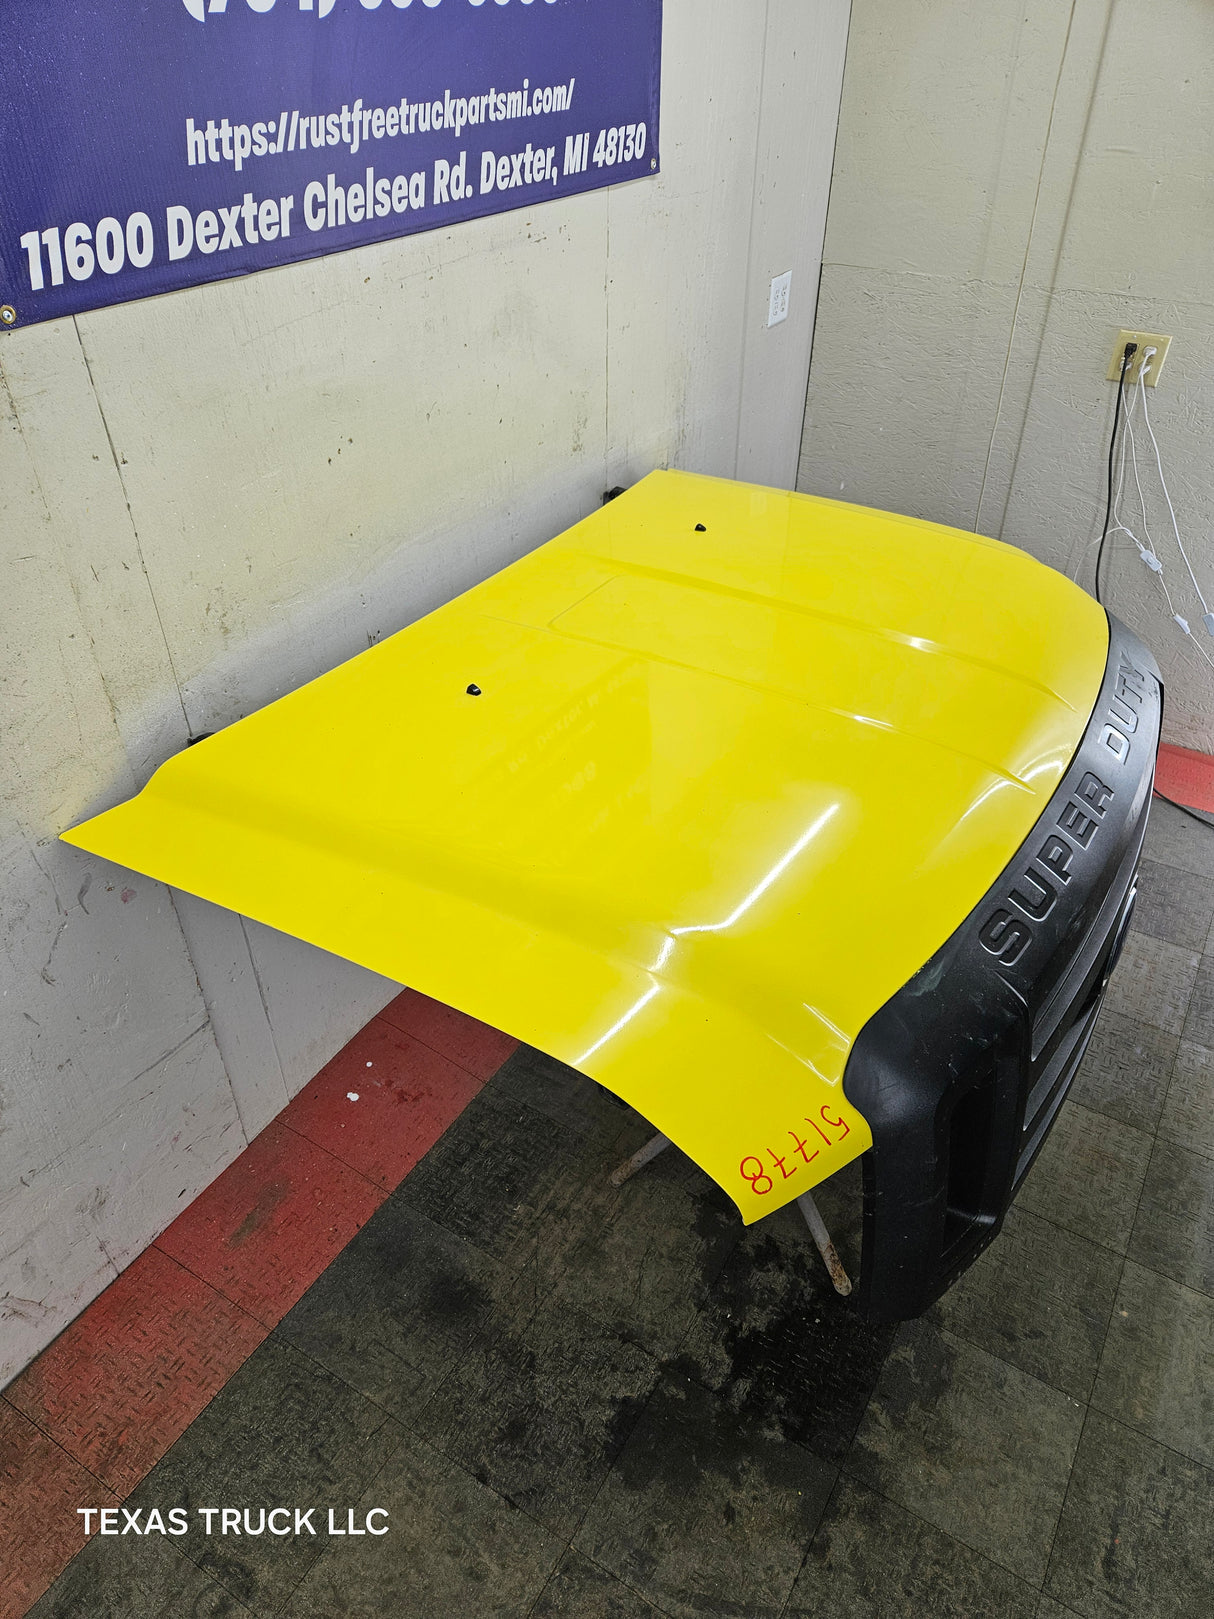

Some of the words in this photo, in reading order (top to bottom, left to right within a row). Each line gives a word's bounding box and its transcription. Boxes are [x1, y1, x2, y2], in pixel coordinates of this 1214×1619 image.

[186, 78, 576, 171] https://rustfreetruckpartsmi.com/
[20, 212, 153, 290] 11600
[166, 193, 293, 260] Dexter
[304, 172, 426, 231] Chelsea
[434, 151, 473, 204] Rd.
[480, 145, 558, 194] Dexter,
[564, 133, 590, 175] MI
[593, 123, 647, 167] 48130
[978, 771, 1115, 966] SUPER
[1098, 648, 1145, 766] DUTY
[740, 1105, 850, 1195] 51778
